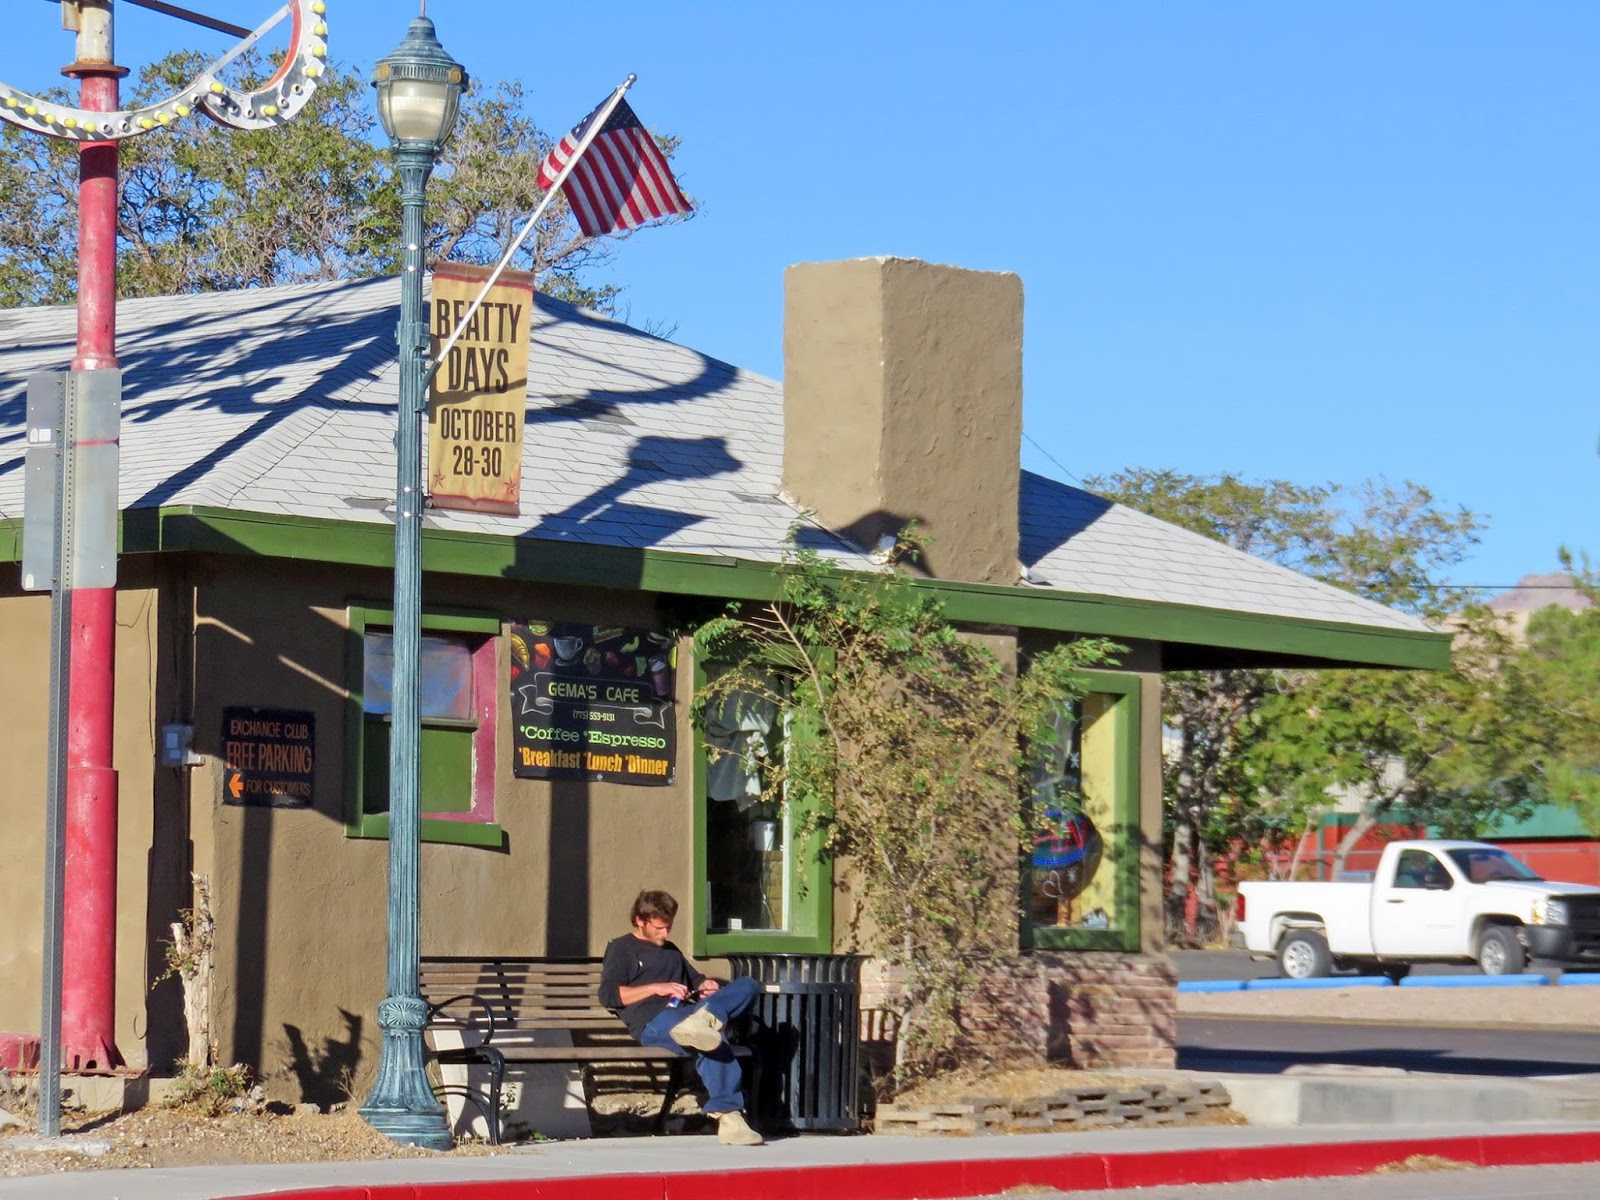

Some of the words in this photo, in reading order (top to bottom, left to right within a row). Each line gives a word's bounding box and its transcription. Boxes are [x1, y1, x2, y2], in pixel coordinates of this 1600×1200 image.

[436, 299, 522, 344] BEATTY
[448, 346, 509, 394] DAYS
[440, 407, 516, 443] OCTOBER
[452, 445, 502, 478] 28-30
[548, 682, 597, 699] GEMA'S
[606, 687, 639, 703] CAFE
[230, 720, 280, 737] EXCHANGE
[284, 724, 309, 739] CLUB
[227, 741, 255, 770] FREE
[258, 743, 312, 773] PARKING
[246, 779, 261, 793] FOR
[264, 780, 311, 796] CUSTOMERS
